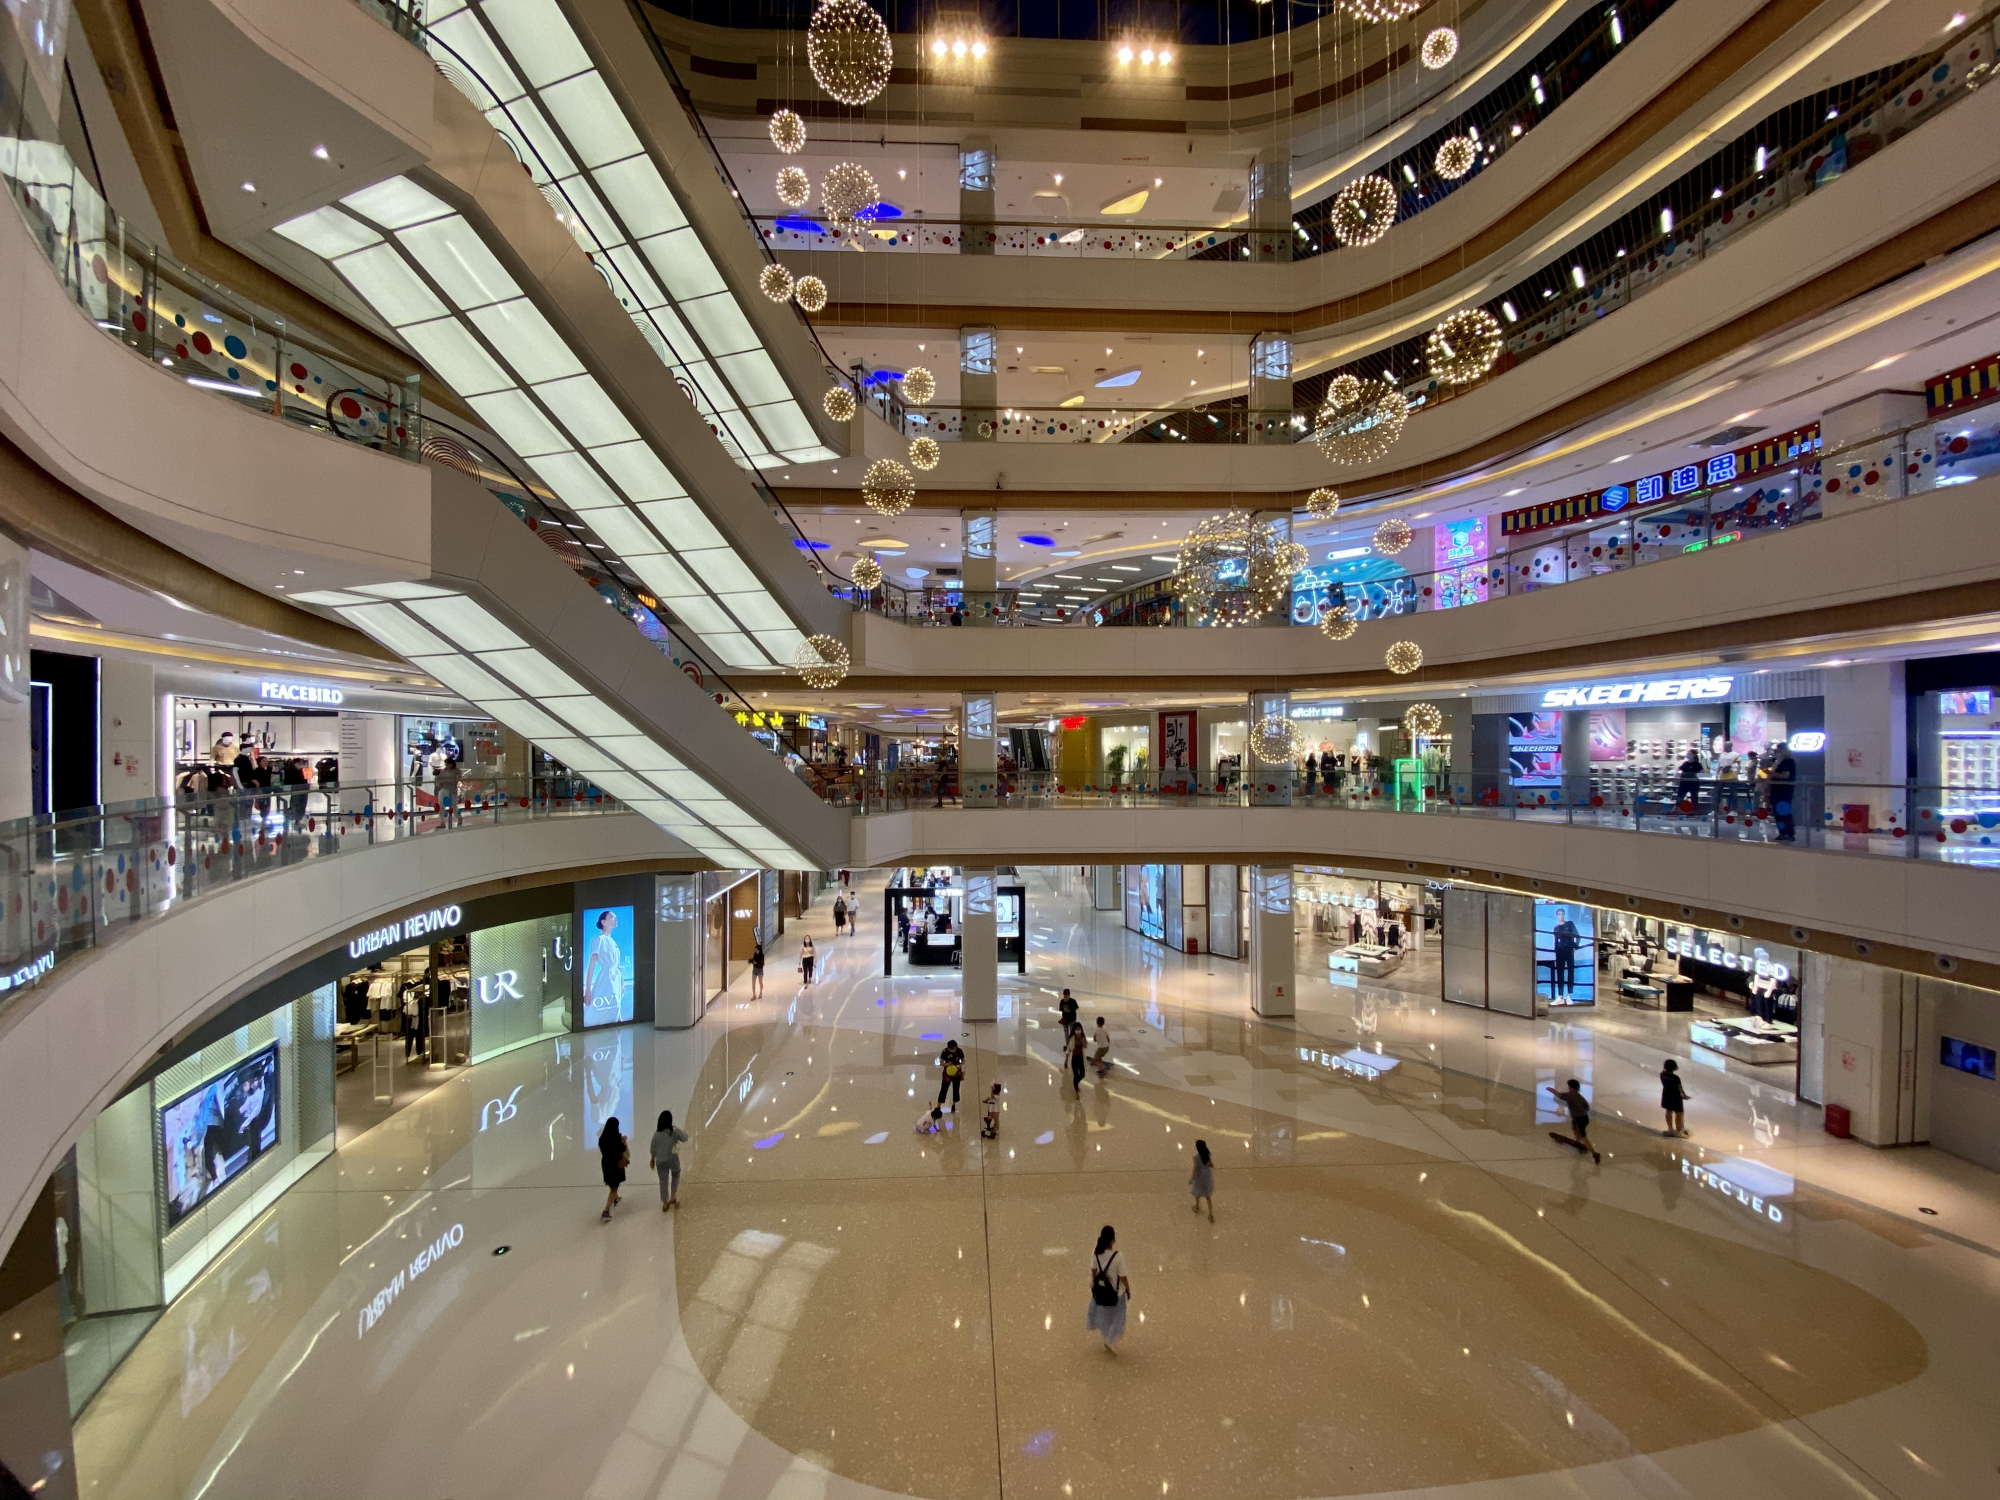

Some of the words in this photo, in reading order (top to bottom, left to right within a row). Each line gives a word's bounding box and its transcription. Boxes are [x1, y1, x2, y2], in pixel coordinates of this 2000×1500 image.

[1636, 452, 1737, 504] 凯迪思
[261, 682, 343, 704] PEACEBIRD
[1541, 676, 1734, 708] SKECHERS
[1511, 744, 1559, 752] SKECHERS
[1293, 886, 1377, 910] ELECTED
[350, 923, 401, 960] URBAN
[404, 904, 462, 942] REVIVO
[1665, 936, 1790, 982] SELECTED
[477, 969, 524, 1004] UR
